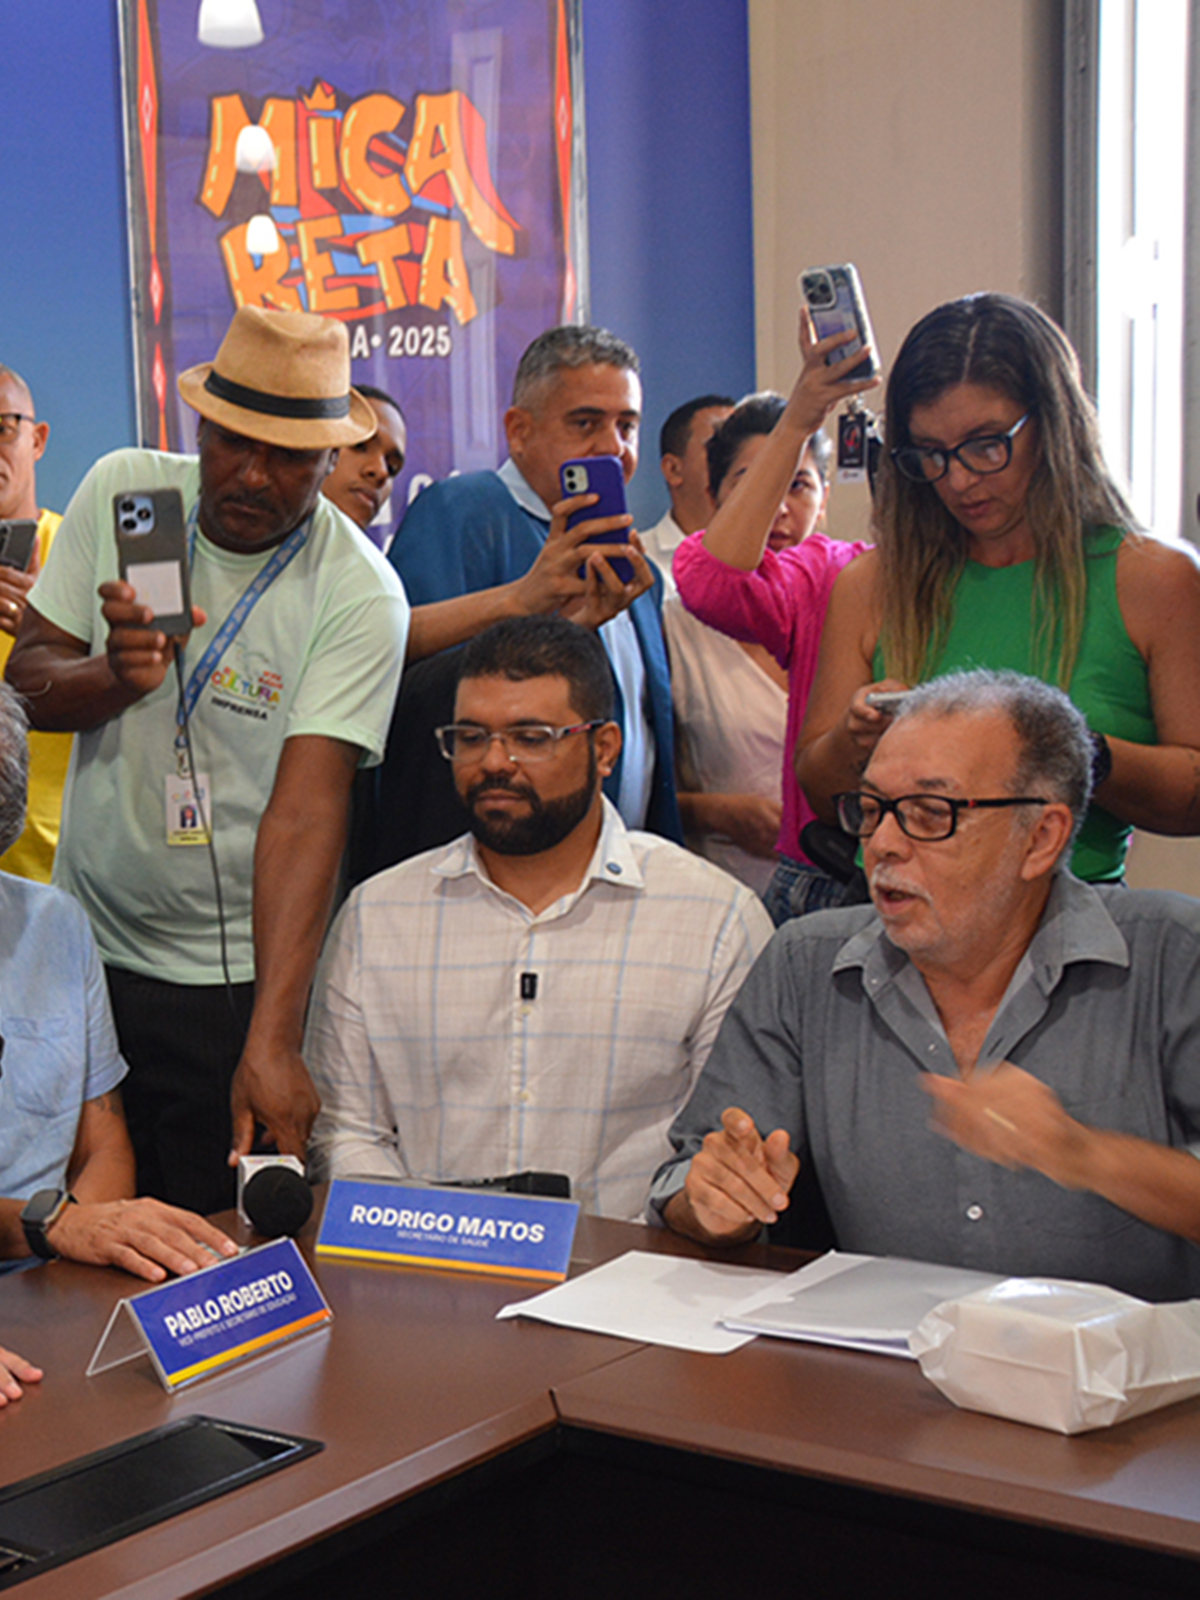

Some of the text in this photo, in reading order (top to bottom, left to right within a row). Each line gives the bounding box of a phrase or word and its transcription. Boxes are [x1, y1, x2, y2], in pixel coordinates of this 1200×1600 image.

[200, 88, 521, 257] MICA
[219, 214, 478, 326] RETA
[388, 324, 452, 357] 2025
[350, 1204, 546, 1243] RODRIGO MATOS
[163, 1270, 293, 1338] PABLO ROBERTO
